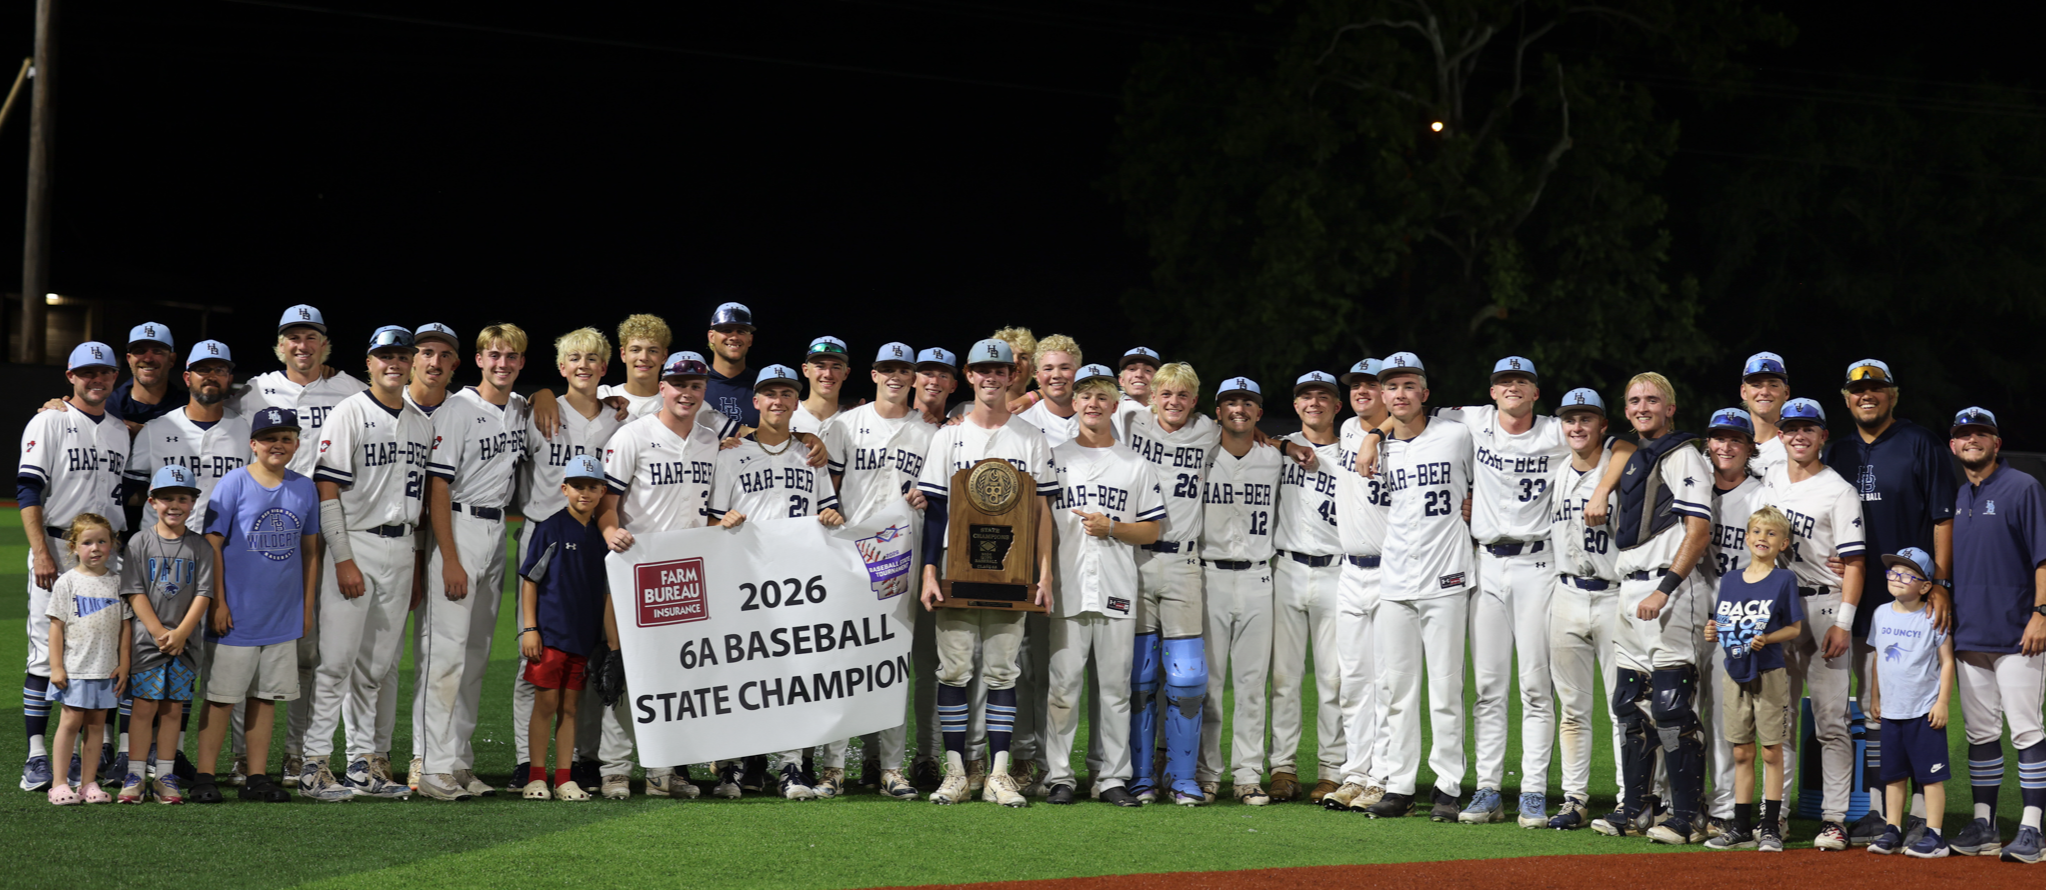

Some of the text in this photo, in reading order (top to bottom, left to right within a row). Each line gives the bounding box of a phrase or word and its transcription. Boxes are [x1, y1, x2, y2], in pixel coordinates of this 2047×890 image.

[855, 448, 924, 478] HAR-BER
[1132, 434, 1204, 469] HAR-BER
[739, 467, 814, 494] HAR-BER
[1173, 473, 1199, 499] 26
[1055, 484, 1128, 511] HAR-BER
[1424, 489, 1452, 517] 23
[1249, 511, 1269, 536] 12
[1584, 527, 1609, 555] 20
[148, 557, 195, 585] CATS
[660, 567, 698, 585] FARM
[868, 561, 899, 573] BASEBALL
[875, 562, 909, 578] TOURNAMENT
[82, 597, 103, 614] CATS
[644, 582, 700, 604] BUREAU
[739, 574, 827, 611] 2026
[653, 603, 701, 618] INSURANCE
[1717, 600, 1773, 616] BACK
[680, 613, 895, 669] 6A BASEBALL
[1881, 626, 1922, 639] GO UNCY!
[636, 651, 911, 724] STATE CHAMPION
